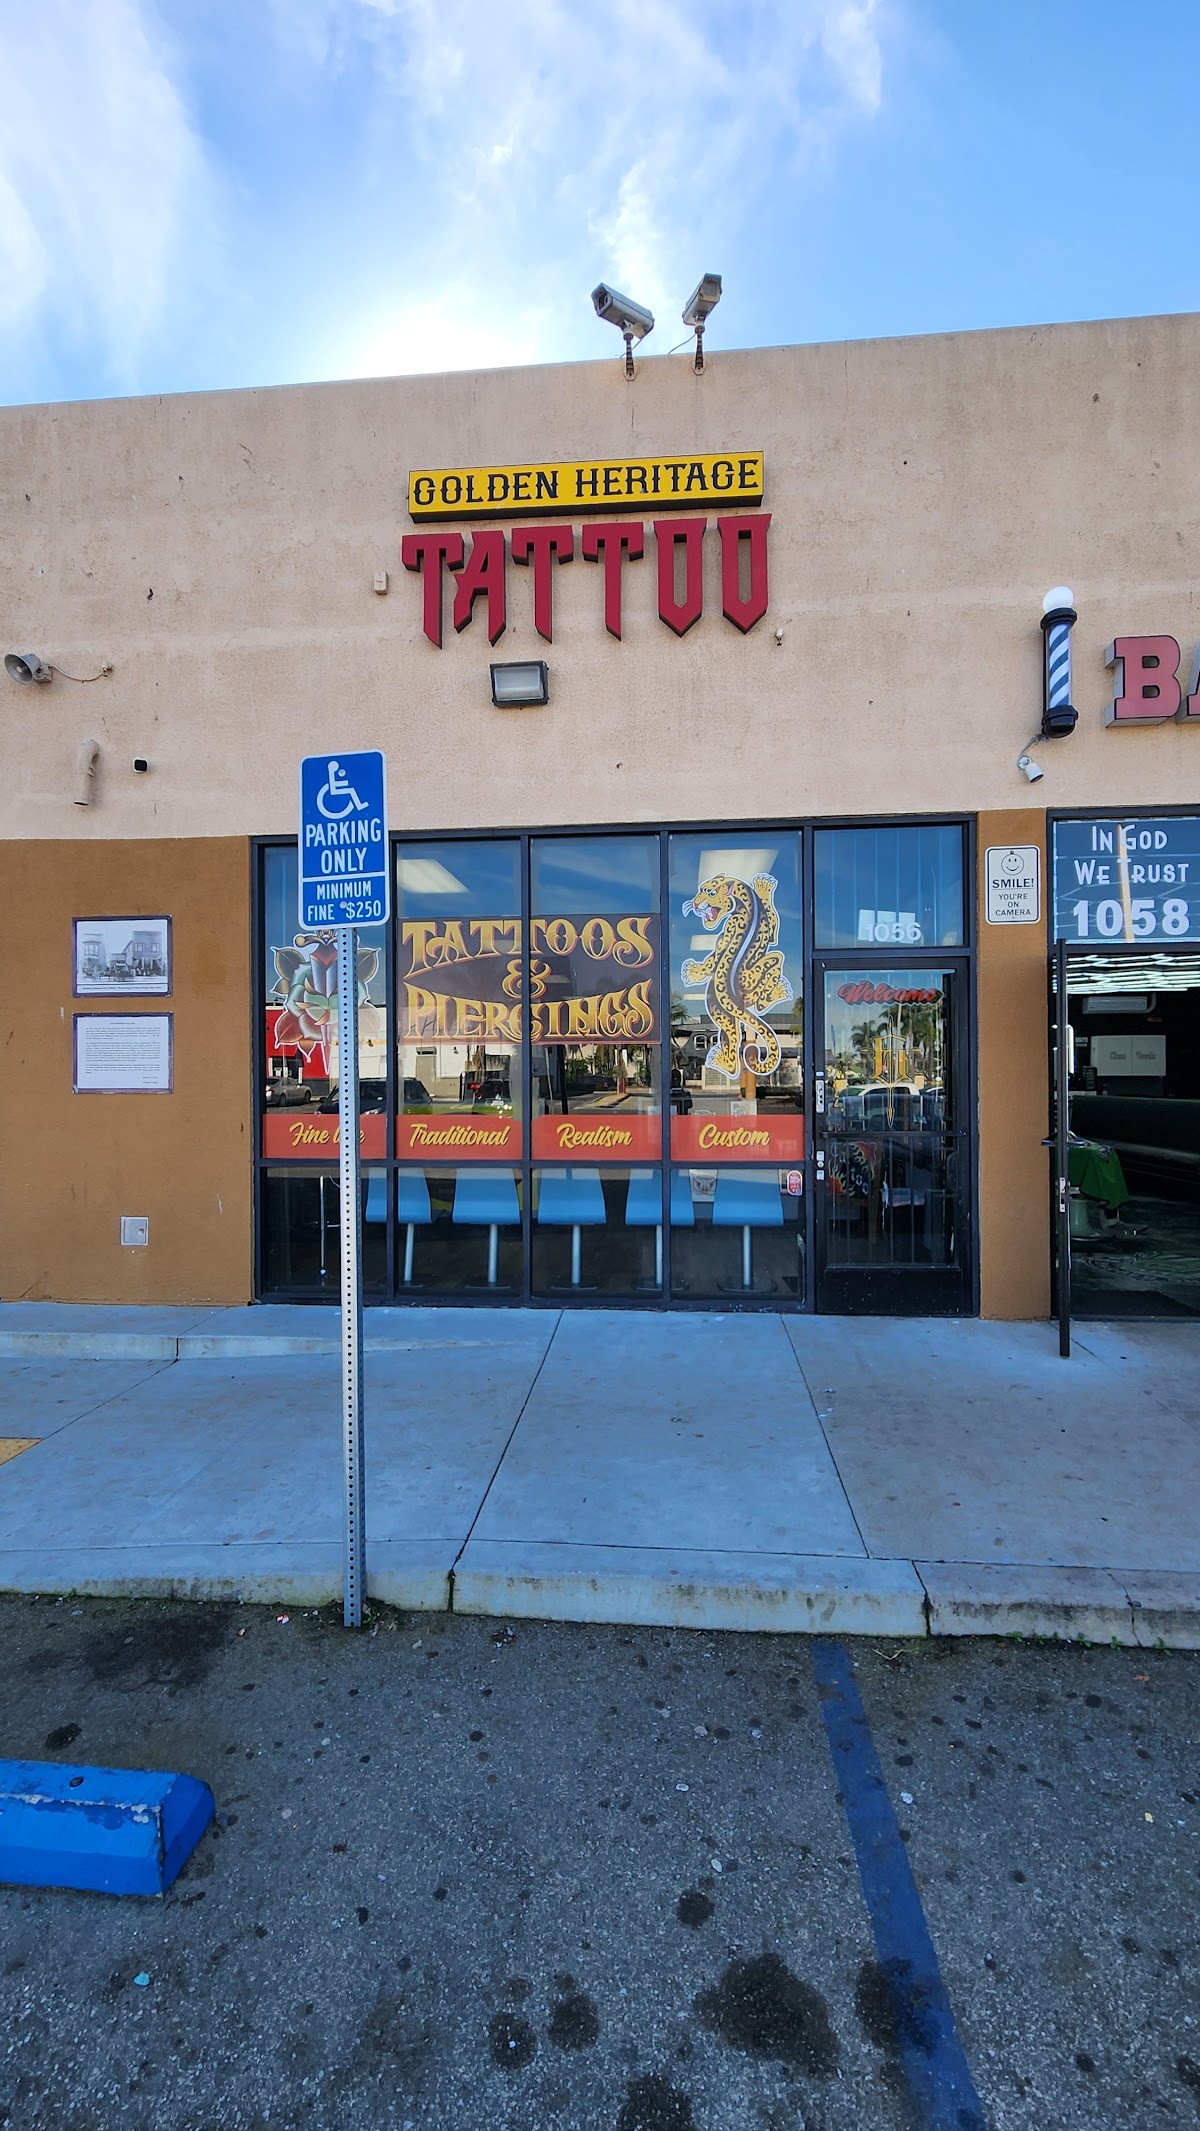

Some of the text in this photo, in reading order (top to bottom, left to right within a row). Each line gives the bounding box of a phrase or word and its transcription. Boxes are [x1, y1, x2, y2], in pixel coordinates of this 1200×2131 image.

[413, 459, 759, 506] GOLDEN HERITAGE
[402, 513, 772, 649] TATTOO
[305, 817, 382, 848] PARKING
[1119, 824, 1168, 850] GOD
[321, 847, 367, 874] ONLY
[1074, 858, 1190, 885] WE TRUST
[316, 880, 372, 900] MINIMUM
[992, 877, 1035, 889] SMILE!
[998, 892, 1028, 900] YOU'RE
[307, 899, 382, 922] FINE $250
[995, 908, 1032, 917] CAMERA
[1073, 898, 1190, 937] 1058
[864, 922, 922, 942] 1056
[401, 916, 655, 980] TATTOOS
[502, 958, 552, 1000] &
[838, 980, 942, 1005] Welcome
[402, 978, 655, 1044] PIERCINGS
[289, 1121, 330, 1147] Fine
[409, 1123, 512, 1148] Traditional
[556, 1123, 633, 1149] Realism
[698, 1123, 771, 1149] Custom
